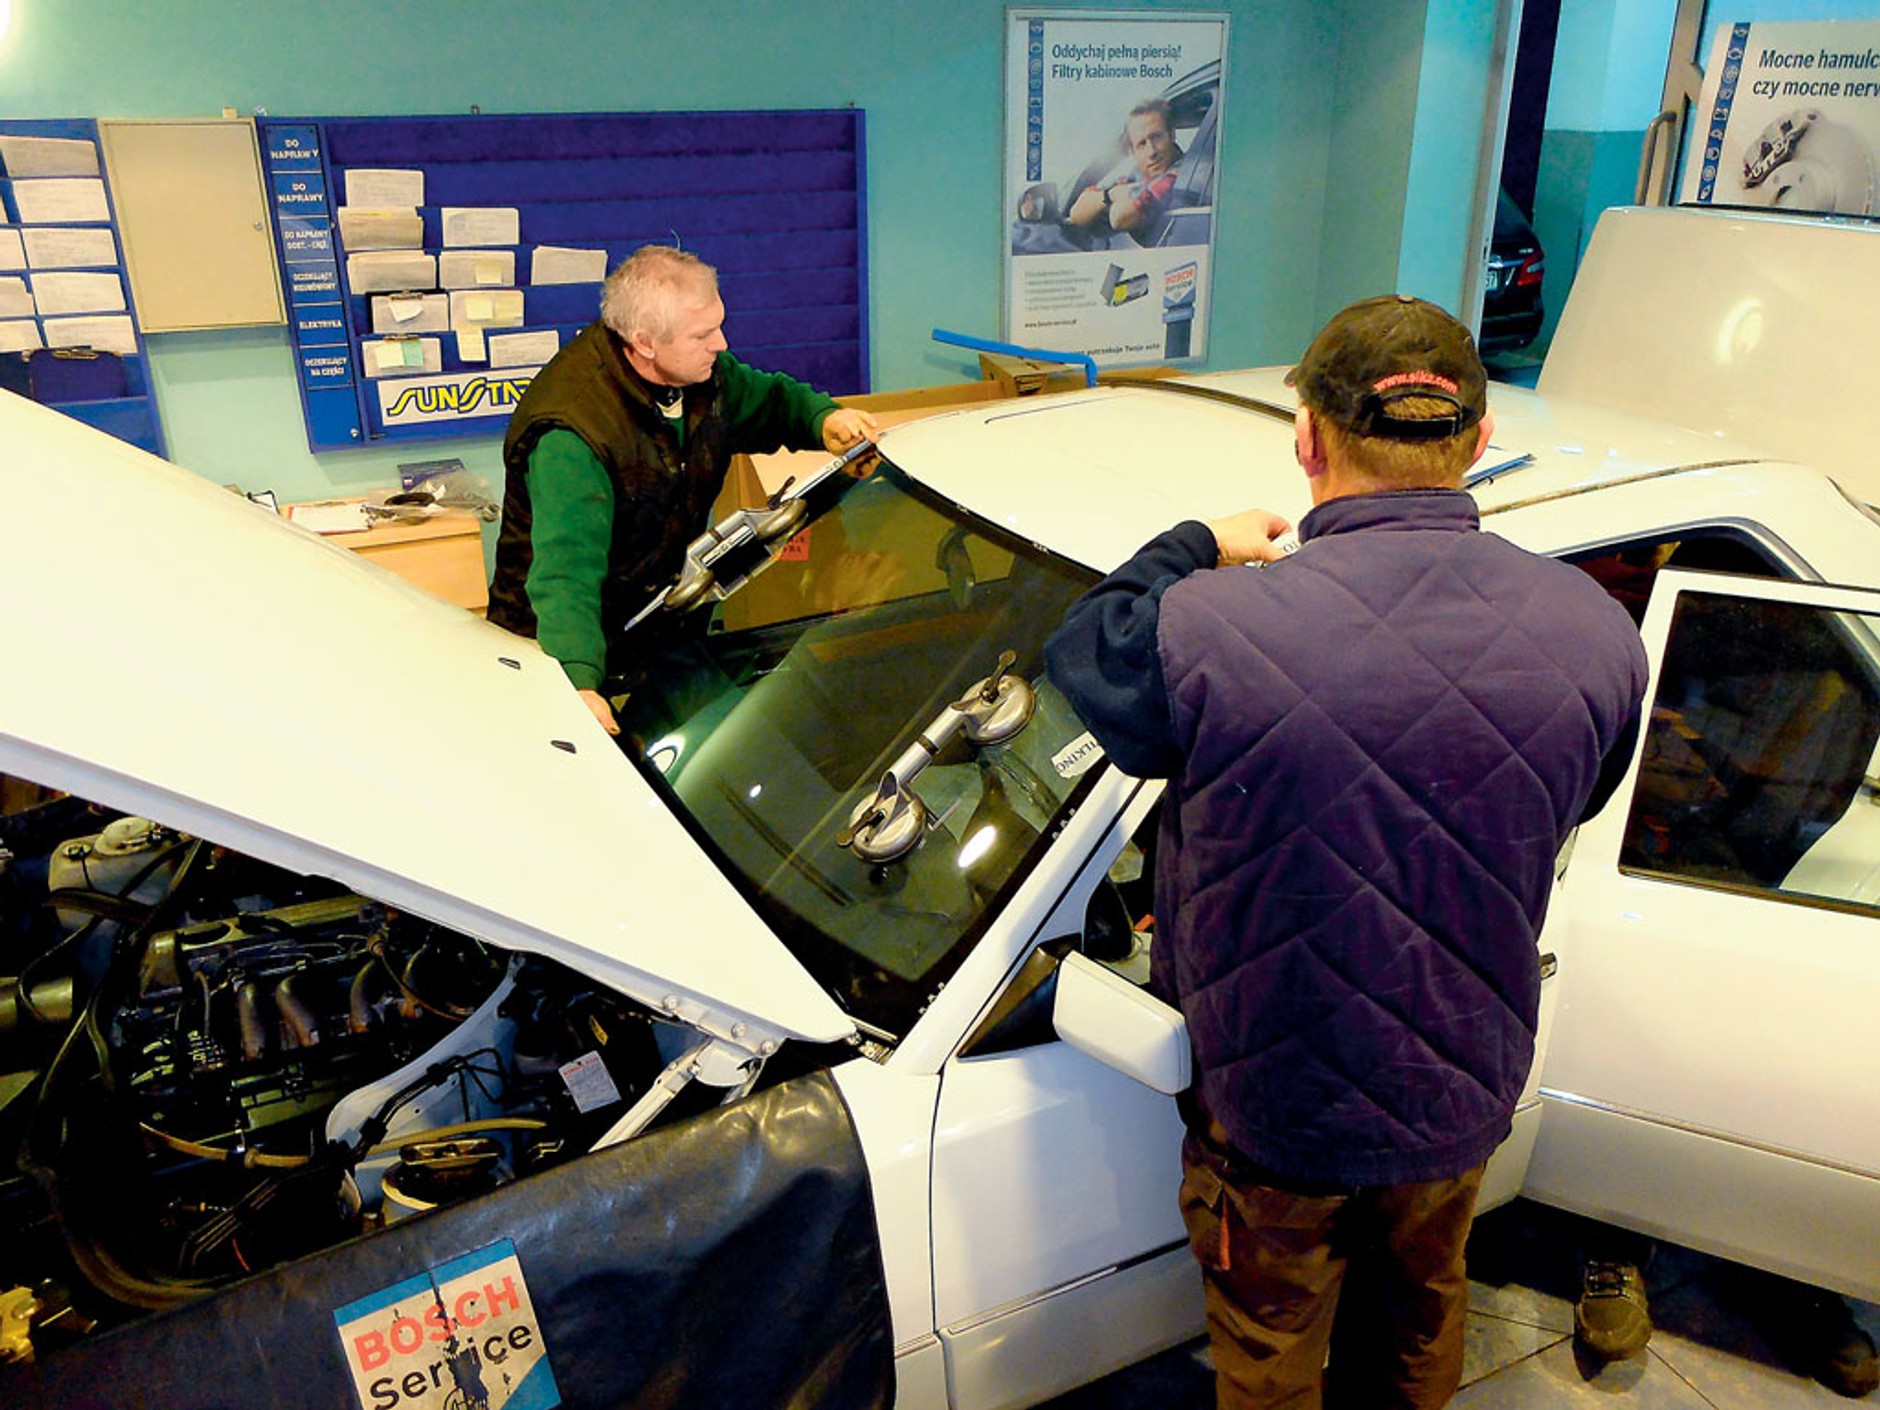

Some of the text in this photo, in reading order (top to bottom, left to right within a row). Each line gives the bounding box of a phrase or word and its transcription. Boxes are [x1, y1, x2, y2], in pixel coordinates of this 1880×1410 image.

[1052, 44, 1182, 61] Oddychaj pełną piersią!
[1759, 49, 1815, 69] Mocne
[1052, 64, 1173, 80] Filtry kabinowe Bosch
[1753, 80, 1780, 99] czy
[1782, 80, 1840, 96] mocne
[285, 139, 299, 148] DO
[292, 183, 306, 191] DO
[278, 194, 323, 203] NAPRAWY
[353, 1275, 521, 1373] BOSCH
[369, 1324, 532, 1410] Serice
